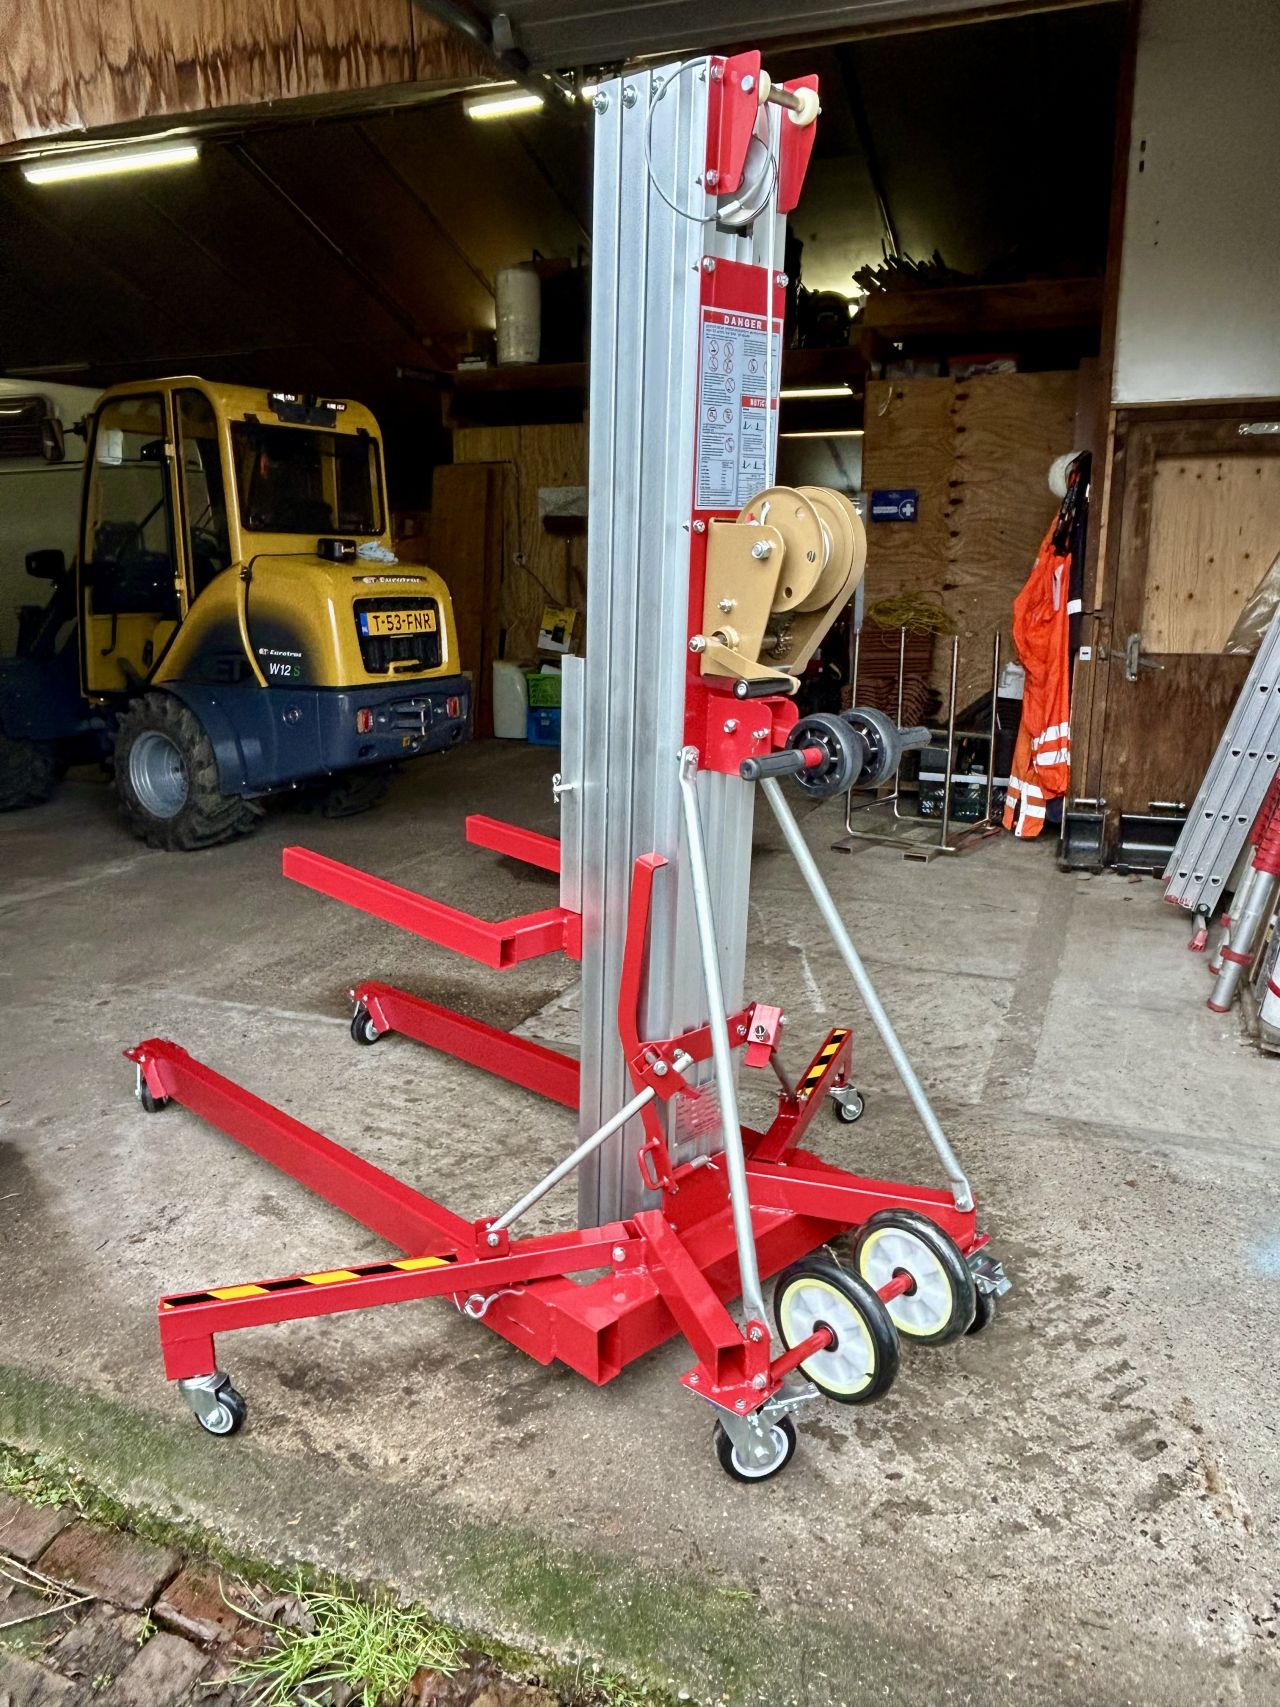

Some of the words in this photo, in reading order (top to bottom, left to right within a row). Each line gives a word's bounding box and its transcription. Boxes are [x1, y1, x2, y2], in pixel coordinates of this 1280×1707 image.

[723, 315, 762, 330] DANGER
[372, 613, 432, 632] T-53-FNR
[269, 662, 291, 676] W12
